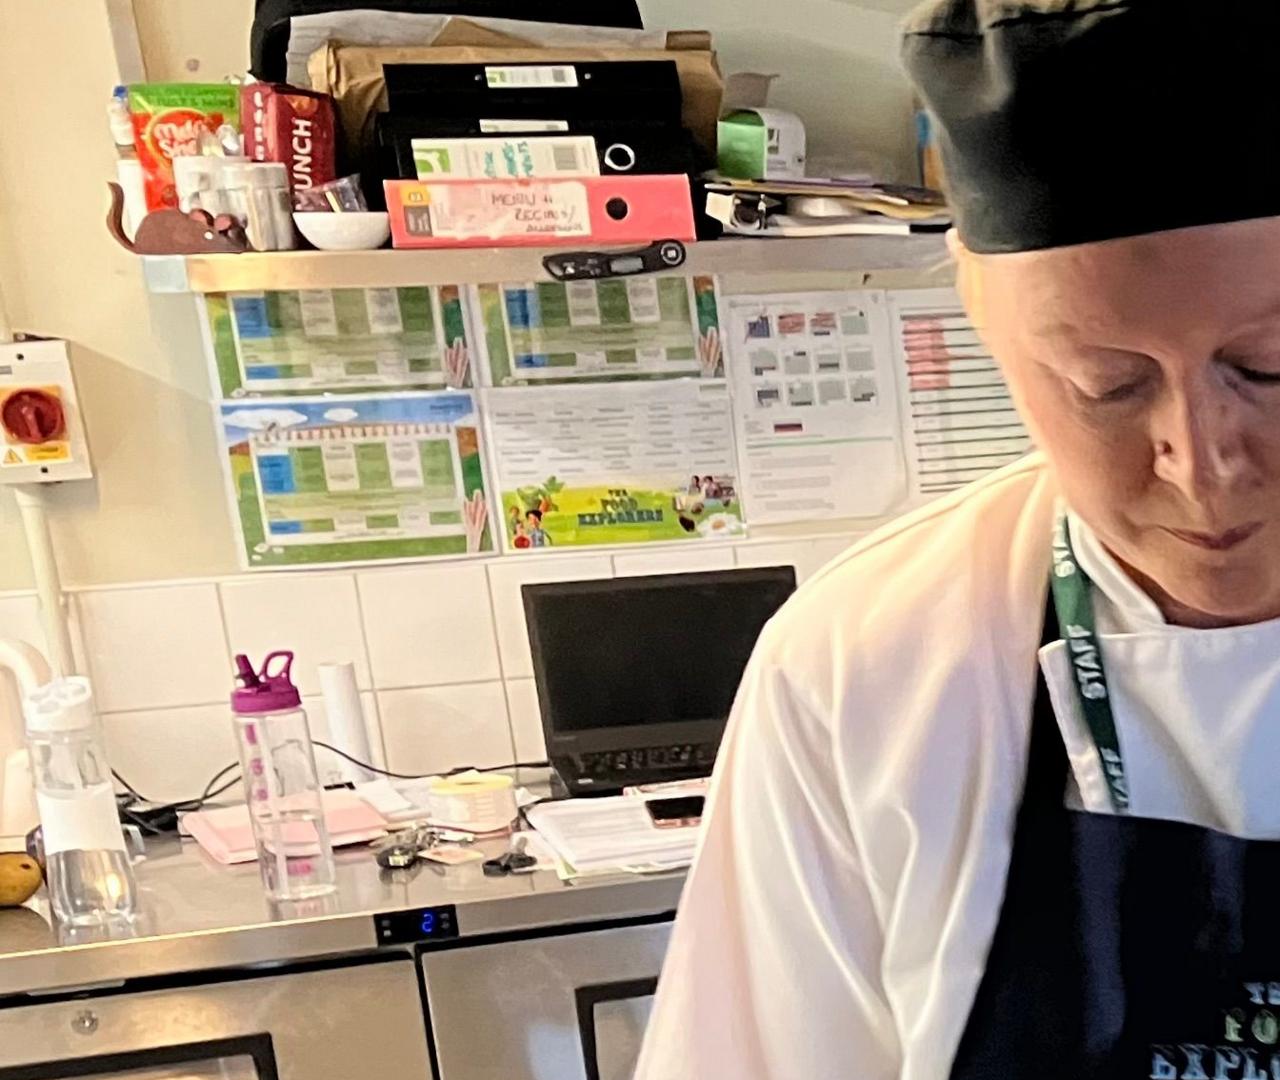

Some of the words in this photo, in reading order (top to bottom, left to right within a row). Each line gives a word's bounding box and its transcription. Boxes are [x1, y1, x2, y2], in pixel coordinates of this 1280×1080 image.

[1066, 623, 1108, 700] STAFF
[1100, 747, 1129, 810] TAFF
[422, 913, 433, 933] 2
